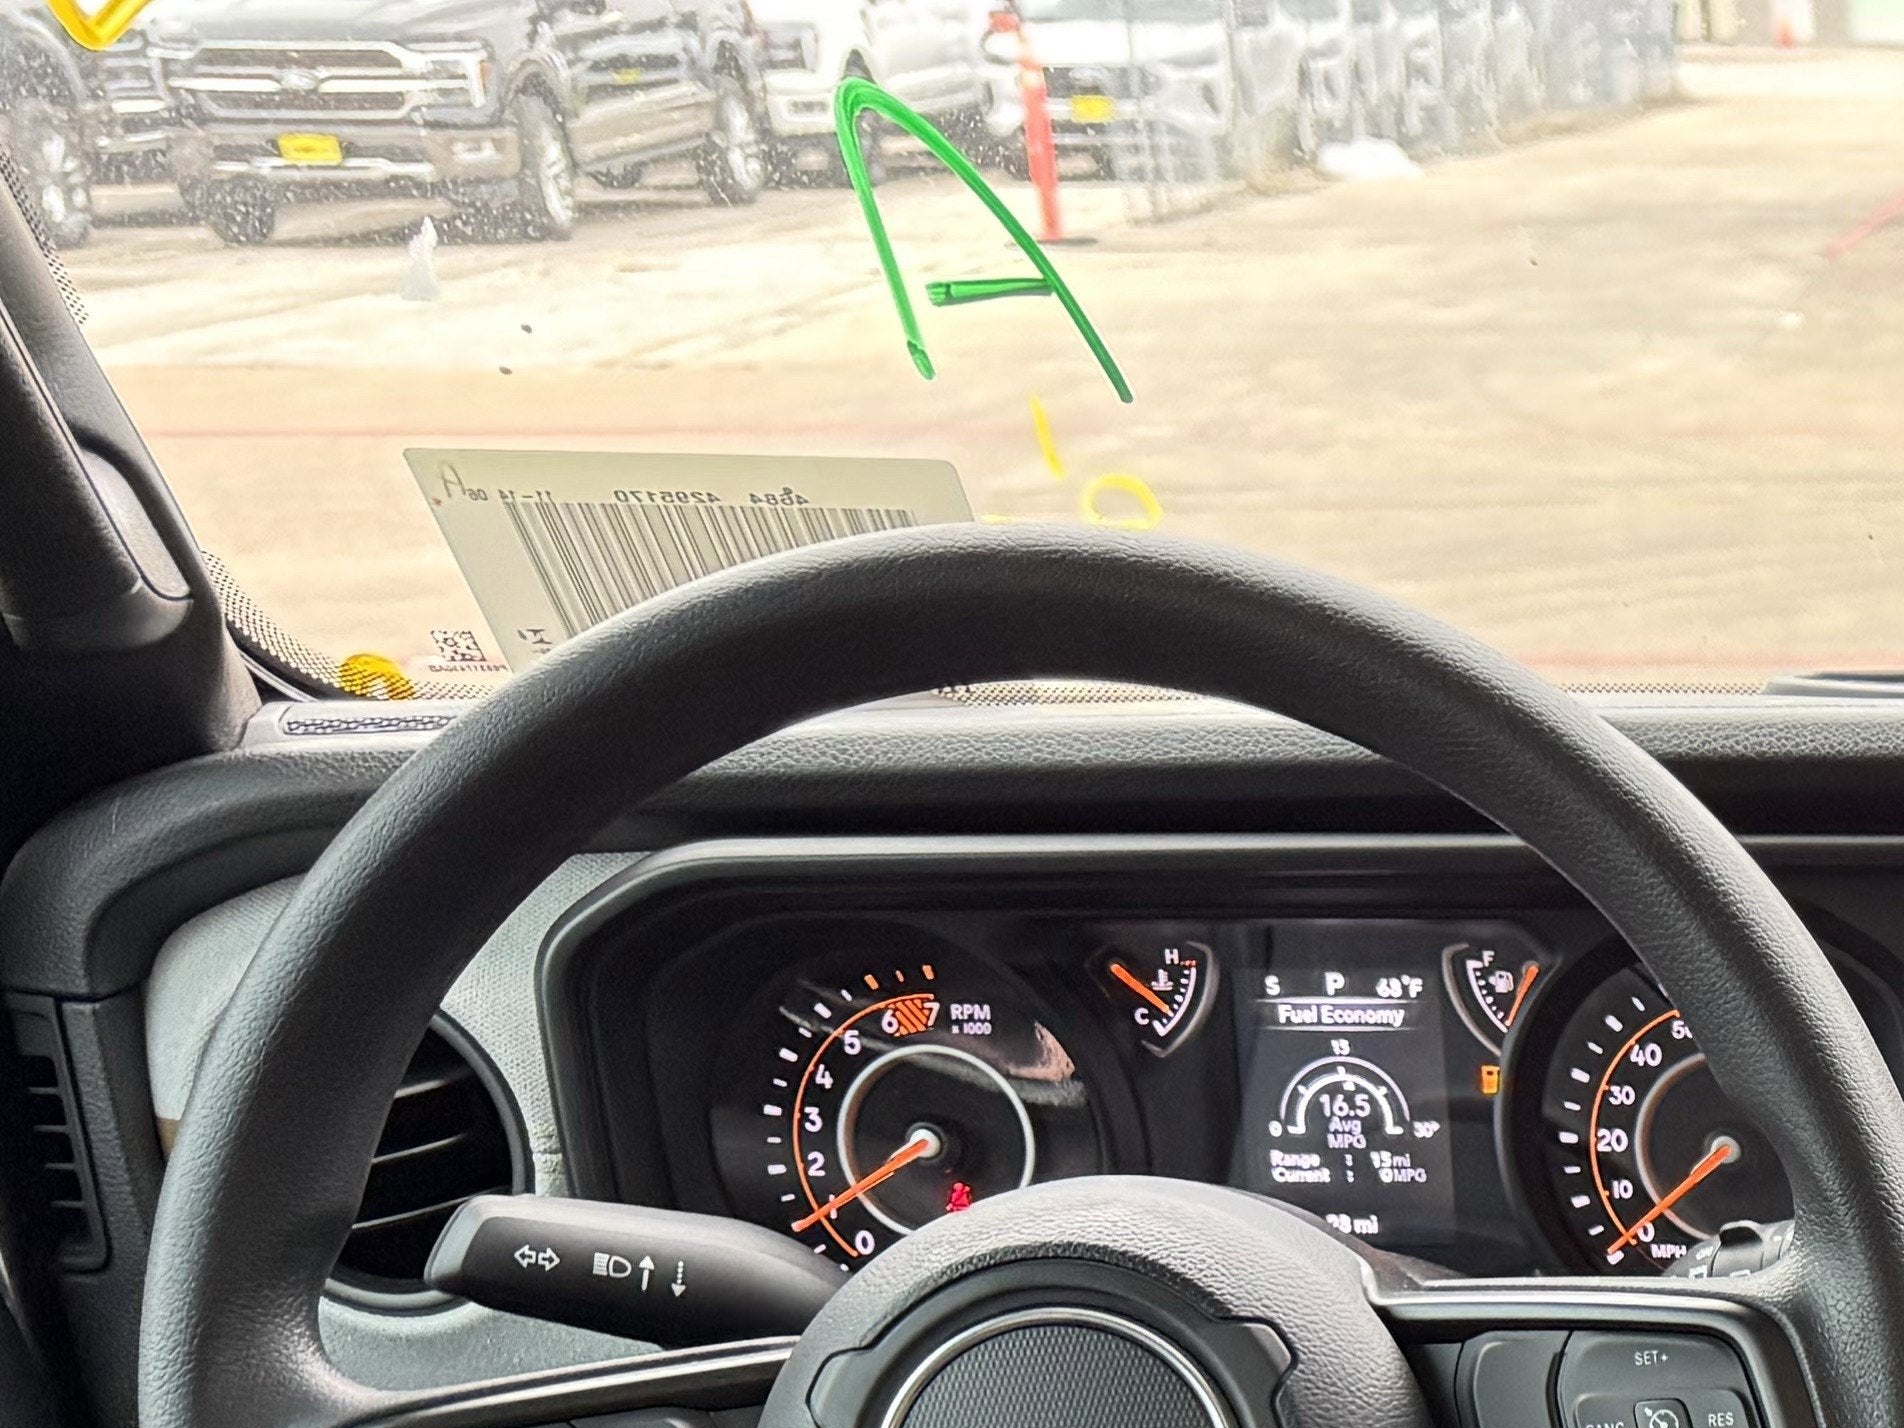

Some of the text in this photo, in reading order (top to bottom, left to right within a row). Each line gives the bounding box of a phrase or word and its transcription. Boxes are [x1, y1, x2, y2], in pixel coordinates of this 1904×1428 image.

[1165, 948, 1179, 965] H
[1483, 950, 1494, 967] F
[1326, 972, 1346, 995] P
[881, 1008, 898, 1034] 6
[922, 1002, 940, 1027] 7
[950, 1003, 991, 1021] RPM
[1134, 1008, 1149, 1025] C
[1278, 1007, 1406, 1028] Fuel Economy
[844, 1030, 861, 1056] 5
[1630, 1043, 1663, 1067] 40
[815, 1063, 834, 1090] 4
[1319, 1094, 1371, 1118] 16.5
[1608, 1085, 1636, 1106] 30
[804, 1106, 823, 1133] 3
[1328, 1117, 1362, 1136] Avg
[1327, 1132, 1367, 1149] MPG
[1597, 1128, 1629, 1152] 20
[807, 1151, 826, 1177] 2
[1269, 1150, 1321, 1169] Range
[1271, 1167, 1331, 1183] Current
[1612, 1179, 1634, 1199] 10
[855, 1230, 875, 1255] 0
[1651, 1244, 1688, 1259] MPH
[1707, 1411, 1735, 1428] RES
